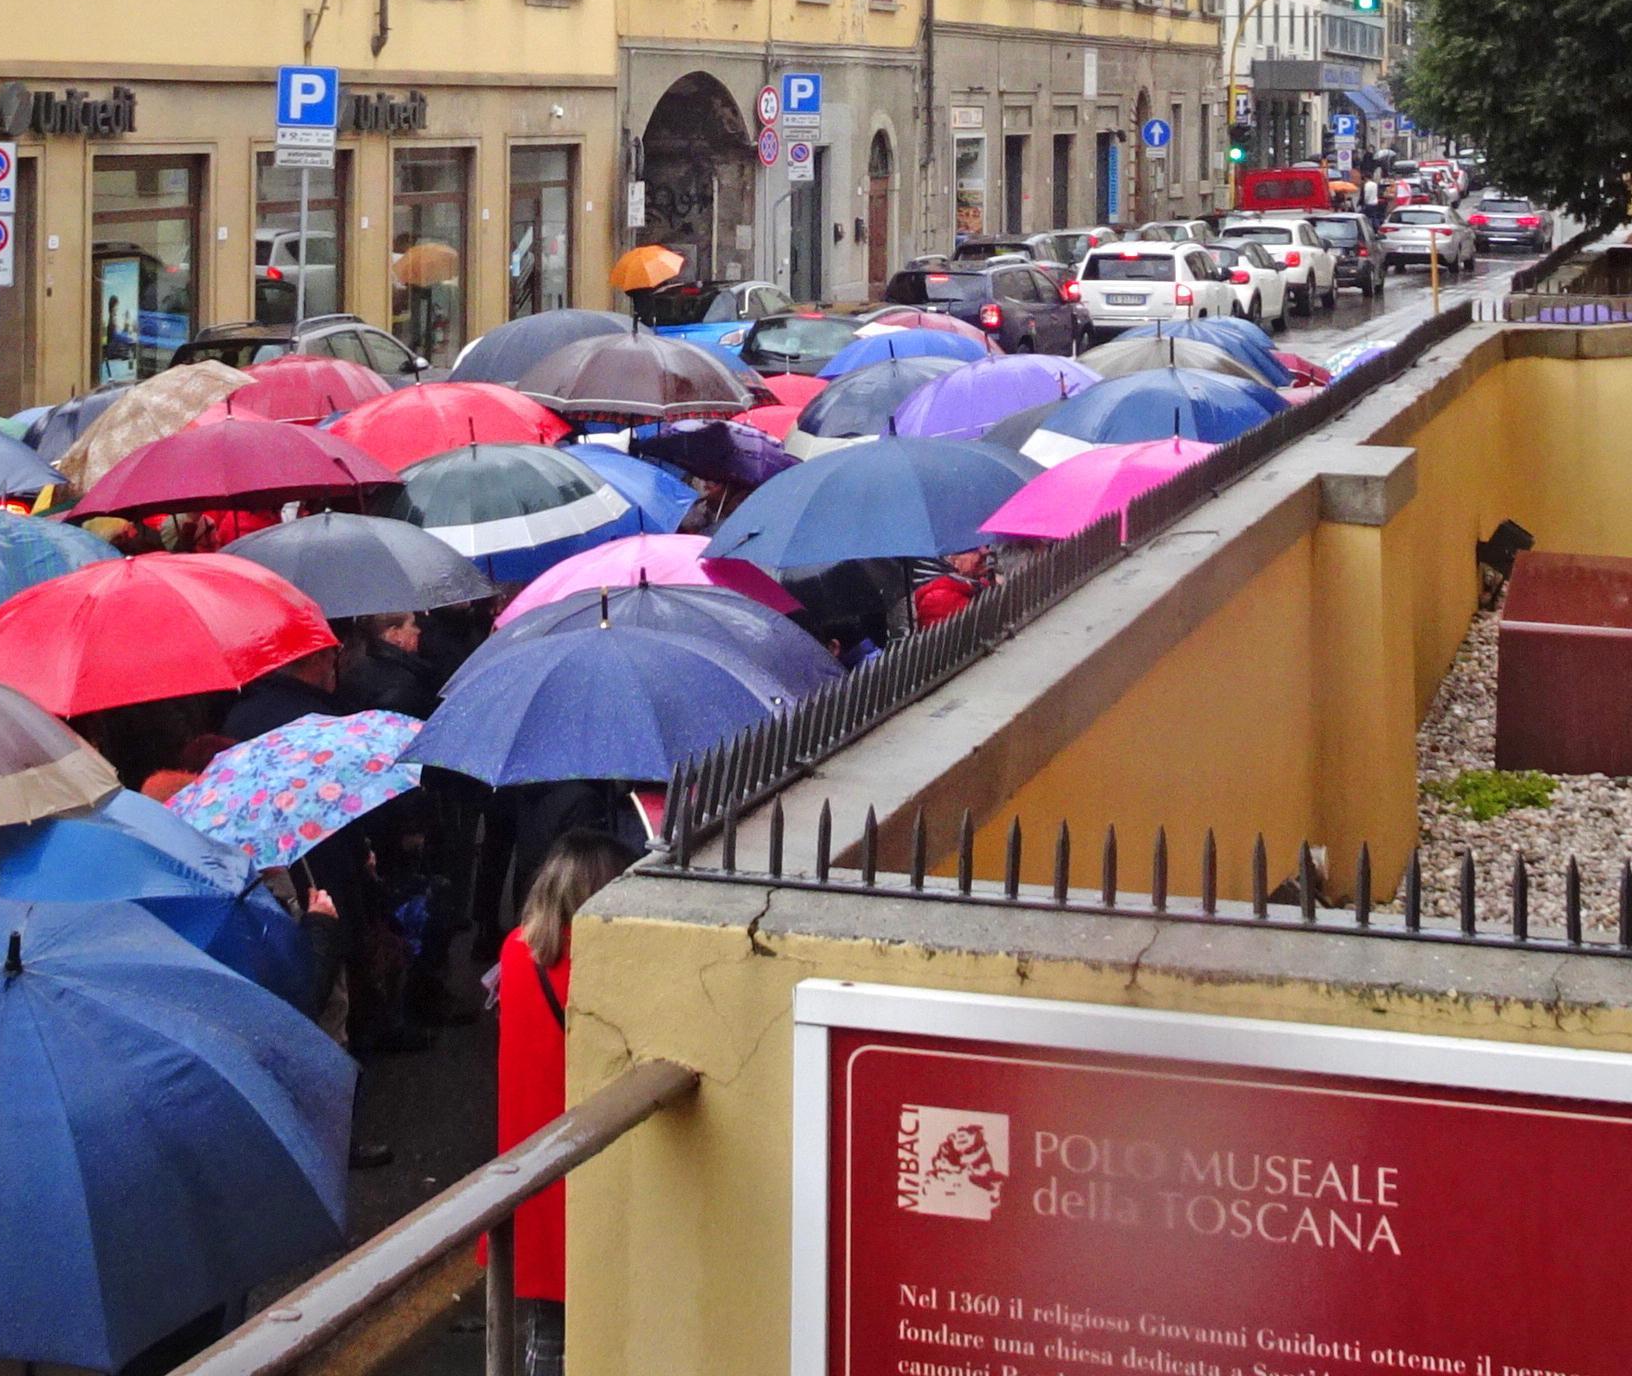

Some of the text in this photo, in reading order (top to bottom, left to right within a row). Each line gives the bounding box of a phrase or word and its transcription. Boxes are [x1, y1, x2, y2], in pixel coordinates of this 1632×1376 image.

[32, 86, 137, 135] UniCredit
[289, 73, 326, 120] P
[790, 78, 814, 109] P
[1034, 1130, 1399, 1208] POLO MUSEALE
[1033, 1175, 1401, 1256] della TOSCANA
[897, 1318, 985, 1350] fondare
[993, 1333, 1035, 1356] una
[1044, 1337, 1114, 1367] chiesa
[1121, 1347, 1221, 1376] dedicata
[898, 1283, 937, 1308] Nel
[948, 1289, 1000, 1317] 1360
[1009, 1297, 1024, 1320] il
[1032, 1303, 1131, 1333] religioso
[1138, 1313, 1248, 1349] Giovanni
[1256, 1327, 1362, 1363] Guidotti
[1370, 1345, 1467, 1375] ottenne
[1475, 1355, 1492, 1376] il
